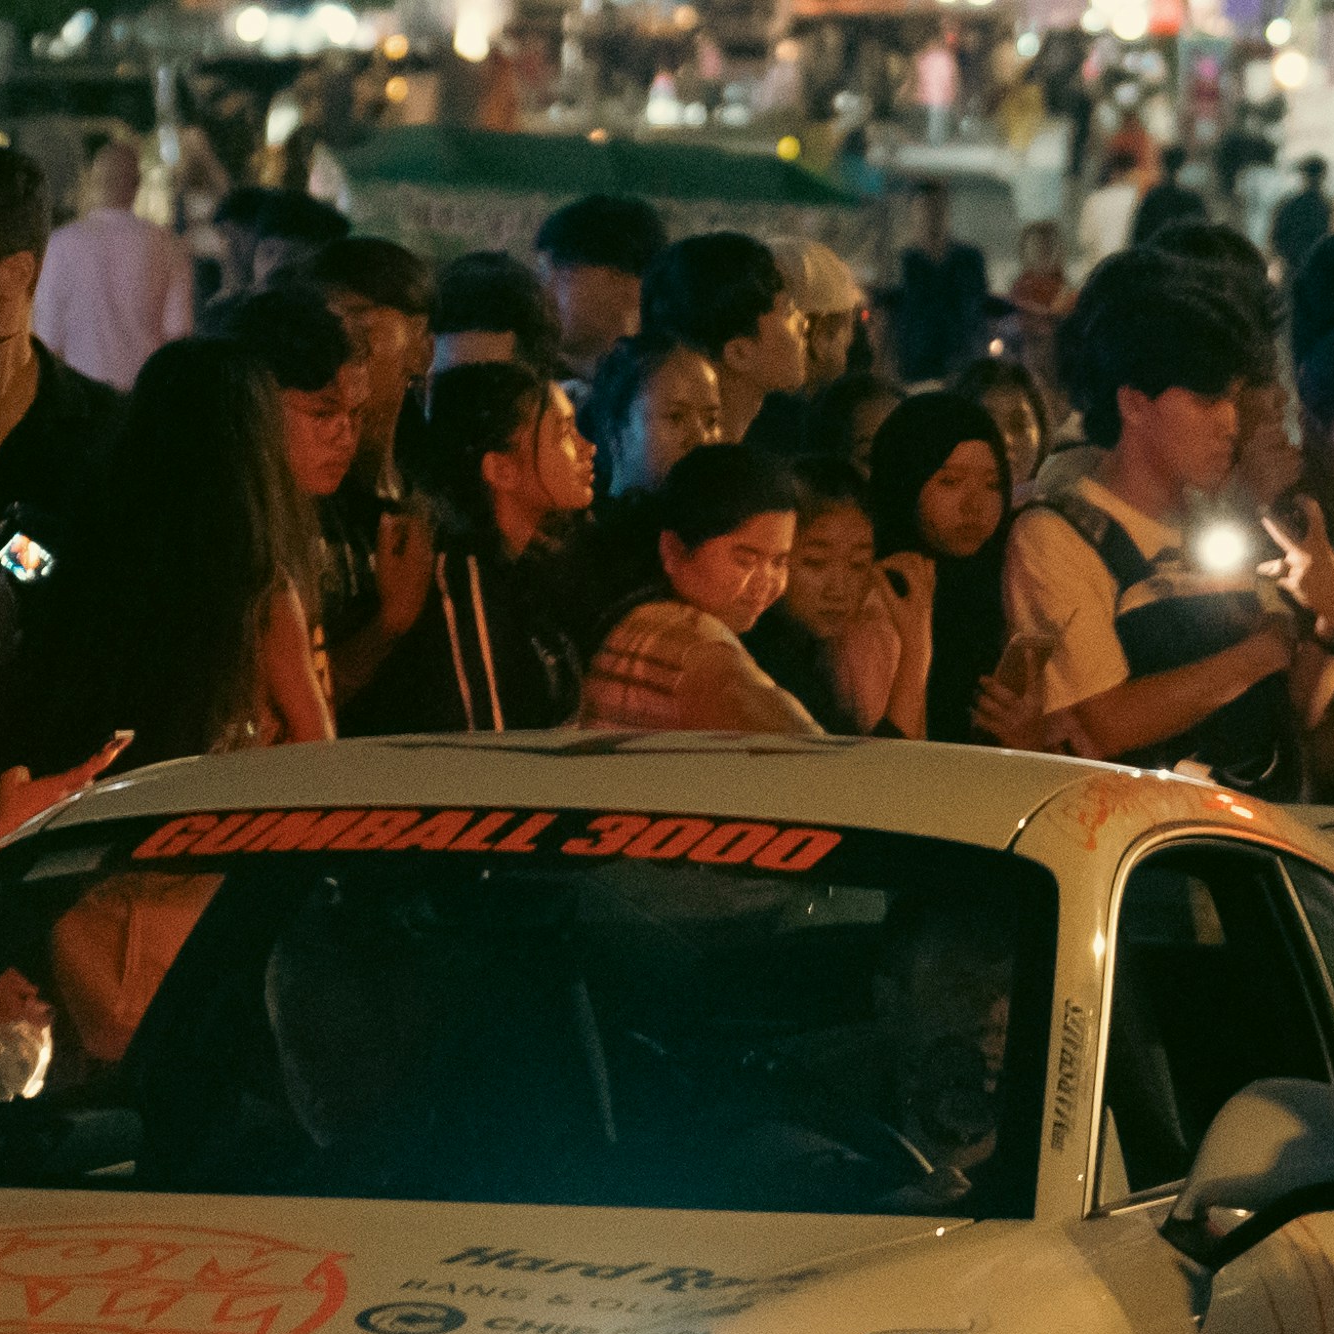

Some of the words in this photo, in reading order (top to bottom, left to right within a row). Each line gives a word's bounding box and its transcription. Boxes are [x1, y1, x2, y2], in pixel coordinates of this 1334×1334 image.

[131, 809, 557, 860] GUMBALL
[560, 816, 843, 872] 3000
[441, 1246, 656, 1281] Hard
